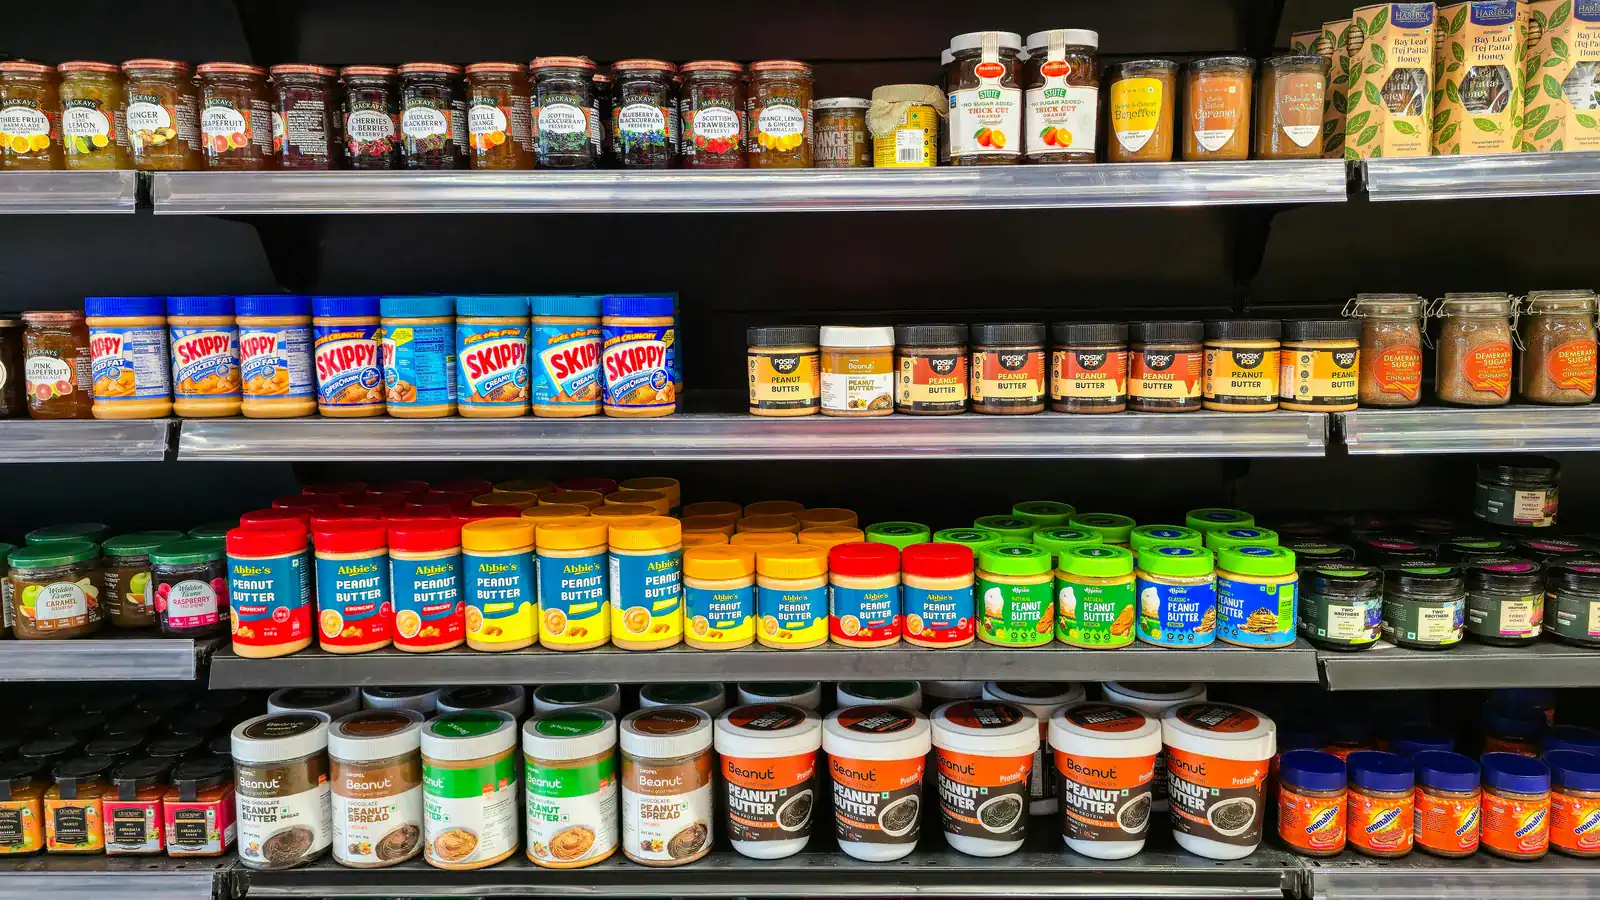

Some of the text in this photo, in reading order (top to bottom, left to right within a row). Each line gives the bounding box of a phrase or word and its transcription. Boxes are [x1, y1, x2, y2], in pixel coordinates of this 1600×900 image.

[1395, 38, 1428, 47] Bay Leaf
[1475, 34, 1512, 45] Bay Leaf
[1577, 33, 1591, 42] Bay
[1489, 43, 1512, 52] Patta)
[1398, 56, 1421, 64] Honey
[1478, 52, 1504, 61] Honey
[545, 95, 577, 105] MACKAYS
[626, 95, 656, 105] MACKAYS
[702, 97, 731, 107] MACKAYS
[766, 97, 796, 106] MACKAYS
[1060, 105, 1077, 113] CUT
[129, 111, 158, 120] GINGER
[351, 118, 387, 127] CHERRIES
[695, 121, 738, 130] STRAWBERRY
[358, 125, 389, 133] BERRIES
[335, 332, 366, 342] CRUNCHY
[621, 332, 657, 343] CRUNCHY
[178, 335, 230, 366] SKIPPY
[1475, 351, 1511, 360] DEMERARA
[1559, 349, 1595, 359] DEMERARA
[213, 357, 233, 369] FAT
[317, 344, 375, 382] SKIPPY
[465, 342, 527, 380] SKIPPY
[606, 345, 665, 383] SKIPPY
[1391, 360, 1415, 368] SUGAR
[1483, 357, 1507, 366] SUGAR
[1567, 356, 1592, 365] SUGAR
[33, 362, 51, 370] PINK
[771, 375, 800, 384] PEANUT
[997, 372, 1028, 380] PEANUT
[1076, 372, 1107, 380] PEANUT
[1143, 372, 1175, 380] PEANUT
[1231, 371, 1264, 379] PEANUT
[484, 373, 511, 391] CREAMY
[571, 372, 595, 391] CREAMY
[928, 377, 957, 385] PEANUT
[997, 382, 1027, 390] BUTTER
[1075, 381, 1105, 390] BUTTER
[1142, 382, 1173, 390] BUTTER
[1231, 380, 1262, 389] BUTTER
[1331, 380, 1356, 389] BUTTER
[771, 385, 800, 393] BUTTER
[928, 386, 956, 394] BUTTER
[337, 563, 378, 575] Abbie's
[415, 563, 454, 576] Abbie's
[478, 562, 517, 574] Abbie's
[562, 562, 601, 574] Abbie's
[647, 558, 680, 571] Abbie's
[233, 564, 271, 576] Abbie's
[335, 576, 380, 589] PEANUT
[413, 576, 456, 590] PEANUT
[477, 575, 520, 587] PEANUT
[561, 575, 602, 588] PEANUT
[645, 570, 681, 586] PEANUT
[233, 578, 274, 590] PEANUT
[335, 588, 381, 602] BUTTER
[413, 588, 457, 602] BUTTER
[477, 588, 521, 600] BUTTER
[561, 587, 603, 601] BUTTER
[645, 582, 681, 598] BUTTER
[173, 596, 211, 605] RASPBERRY
[233, 591, 275, 602] BUTTER
[712, 593, 738, 602] Abbie's
[781, 593, 808, 602] Abbie's
[863, 592, 889, 601] Abbie's
[926, 593, 953, 602] Abbie's
[46, 599, 78, 608] CARAMEL
[709, 601, 741, 611] PEANUT
[778, 603, 811, 612] PEANUT
[860, 600, 891, 610] PEANUT
[923, 602, 956, 611] PEANUT
[1011, 601, 1041, 611] PEANUT
[1083, 602, 1116, 612] PEANUT
[1167, 602, 1200, 613] PEANUT
[708, 610, 742, 620] BUTTER
[778, 612, 811, 621] BUTTER
[859, 609, 892, 620] BUTTER
[922, 611, 956, 620] BUTTER
[1011, 611, 1041, 621] BUTTER
[1083, 612, 1115, 623] BUTTER
[1167, 611, 1199, 623] BUTTER
[999, 773, 1021, 784] Protein
[1231, 776, 1255, 787] Protein
[728, 782, 778, 803] PEANUT
[832, 780, 880, 805] PEANUT
[1065, 777, 1120, 803] PEANUT
[528, 800, 560, 813] PEANUT
[640, 803, 681, 813] PEANUT
[729, 797, 775, 815] BUTTER
[833, 794, 877, 817] BUTTER
[1065, 791, 1117, 816] BUTTER
[241, 804, 278, 814] PEANUT
[348, 805, 390, 815] PEANUT
[242, 812, 278, 823] BUTTER
[348, 813, 390, 823] SPREAD
[528, 810, 560, 822] BUTTER
[640, 810, 681, 820] SPREAD
[1306, 806, 1340, 834] ovomaltine
[1365, 807, 1402, 834] ovomaltine
[1515, 807, 1547, 837] ovomaltine
